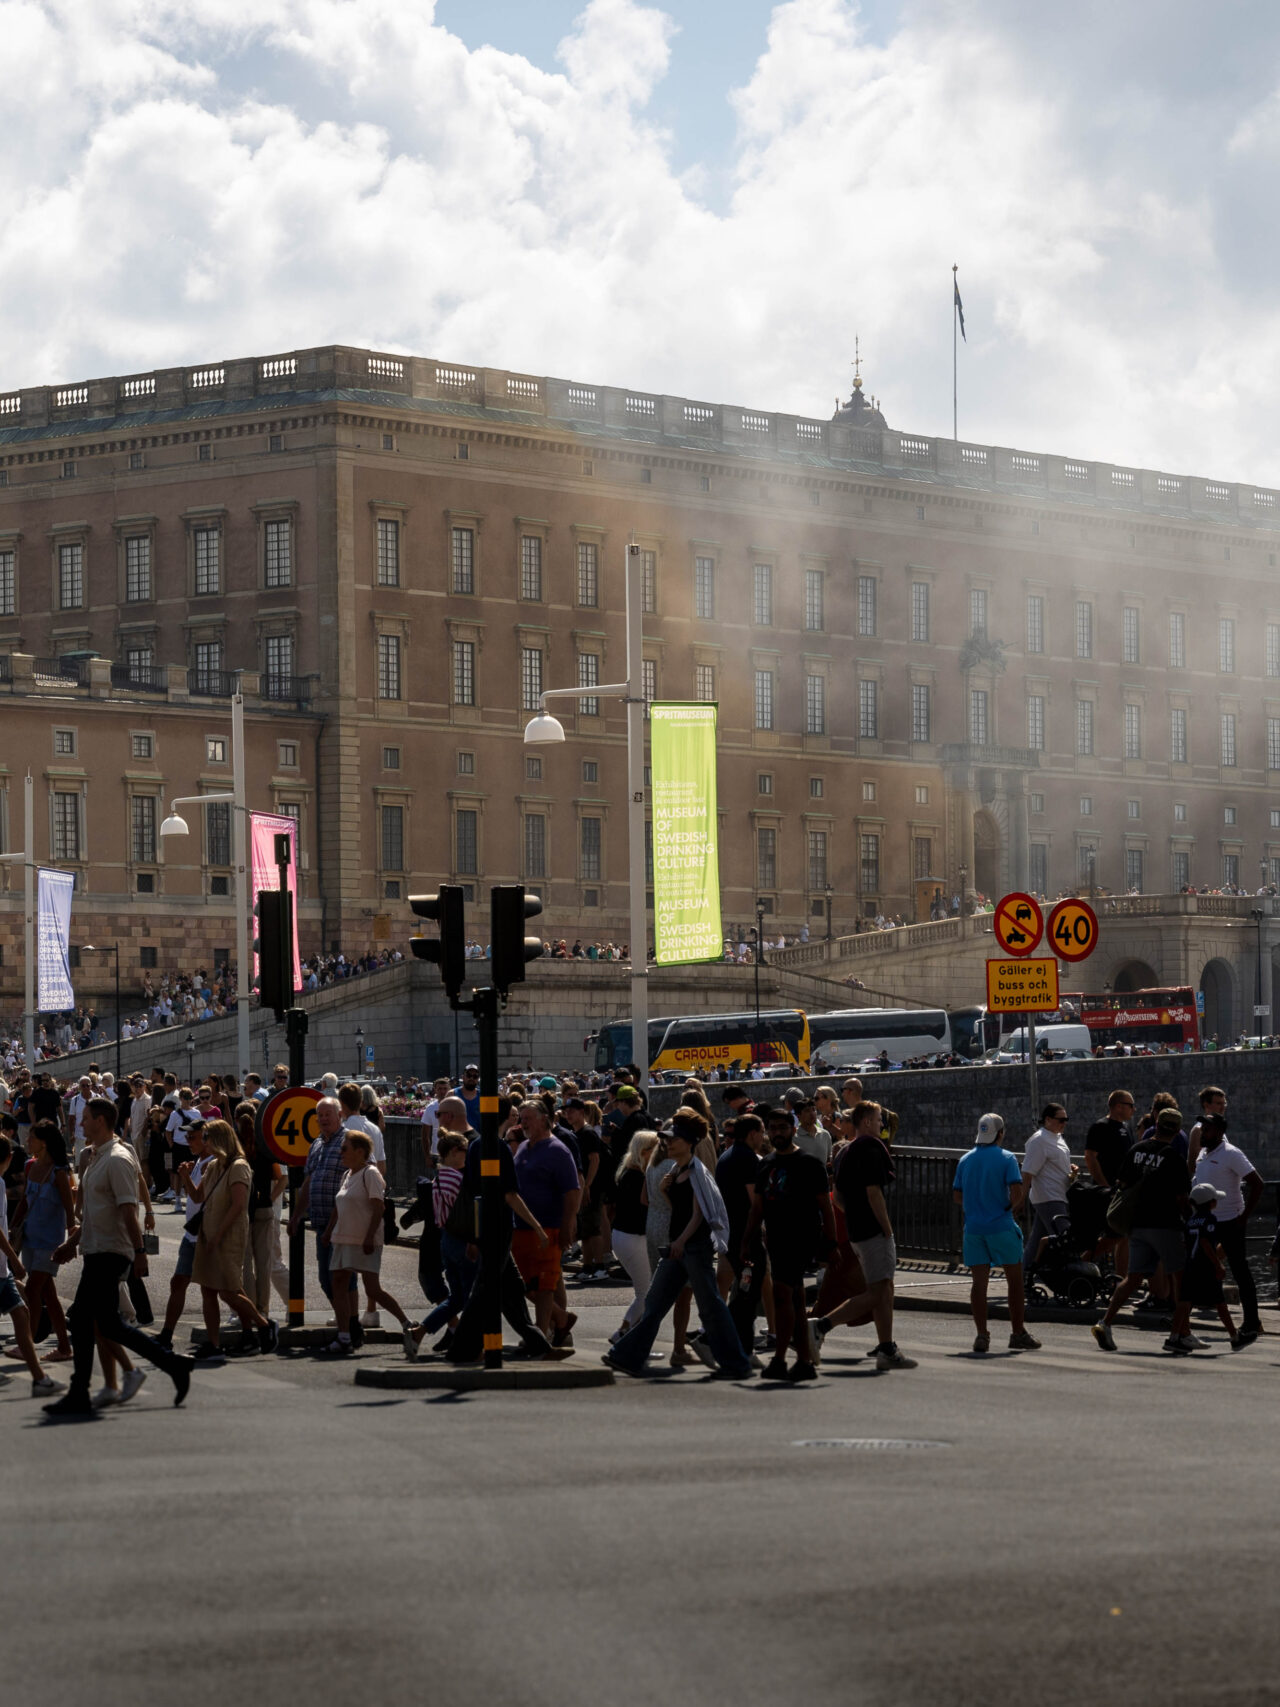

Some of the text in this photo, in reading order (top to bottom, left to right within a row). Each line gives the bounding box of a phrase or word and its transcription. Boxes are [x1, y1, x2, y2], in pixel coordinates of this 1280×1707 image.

[654, 710, 714, 719] SPRITMUSEUM
[656, 806, 707, 818] MUSEUM
[656, 820, 673, 832] OF
[657, 832, 708, 844] SWEDISH
[657, 843, 715, 857] DRINKING
[657, 856, 706, 869] CULTURE
[659, 898, 710, 912] MUSEUM
[659, 912, 675, 924] OF
[660, 922, 711, 936] SWEDISH
[1055, 915, 1091, 946] 40
[660, 934, 719, 949] DRINKING
[660, 948, 709, 962] CULTURE
[999, 964, 1047, 976] Gäller ej
[998, 980, 1048, 990] buss och
[994, 994, 1052, 1006] byggtrafik
[674, 1046, 730, 1060] CAROLUS
